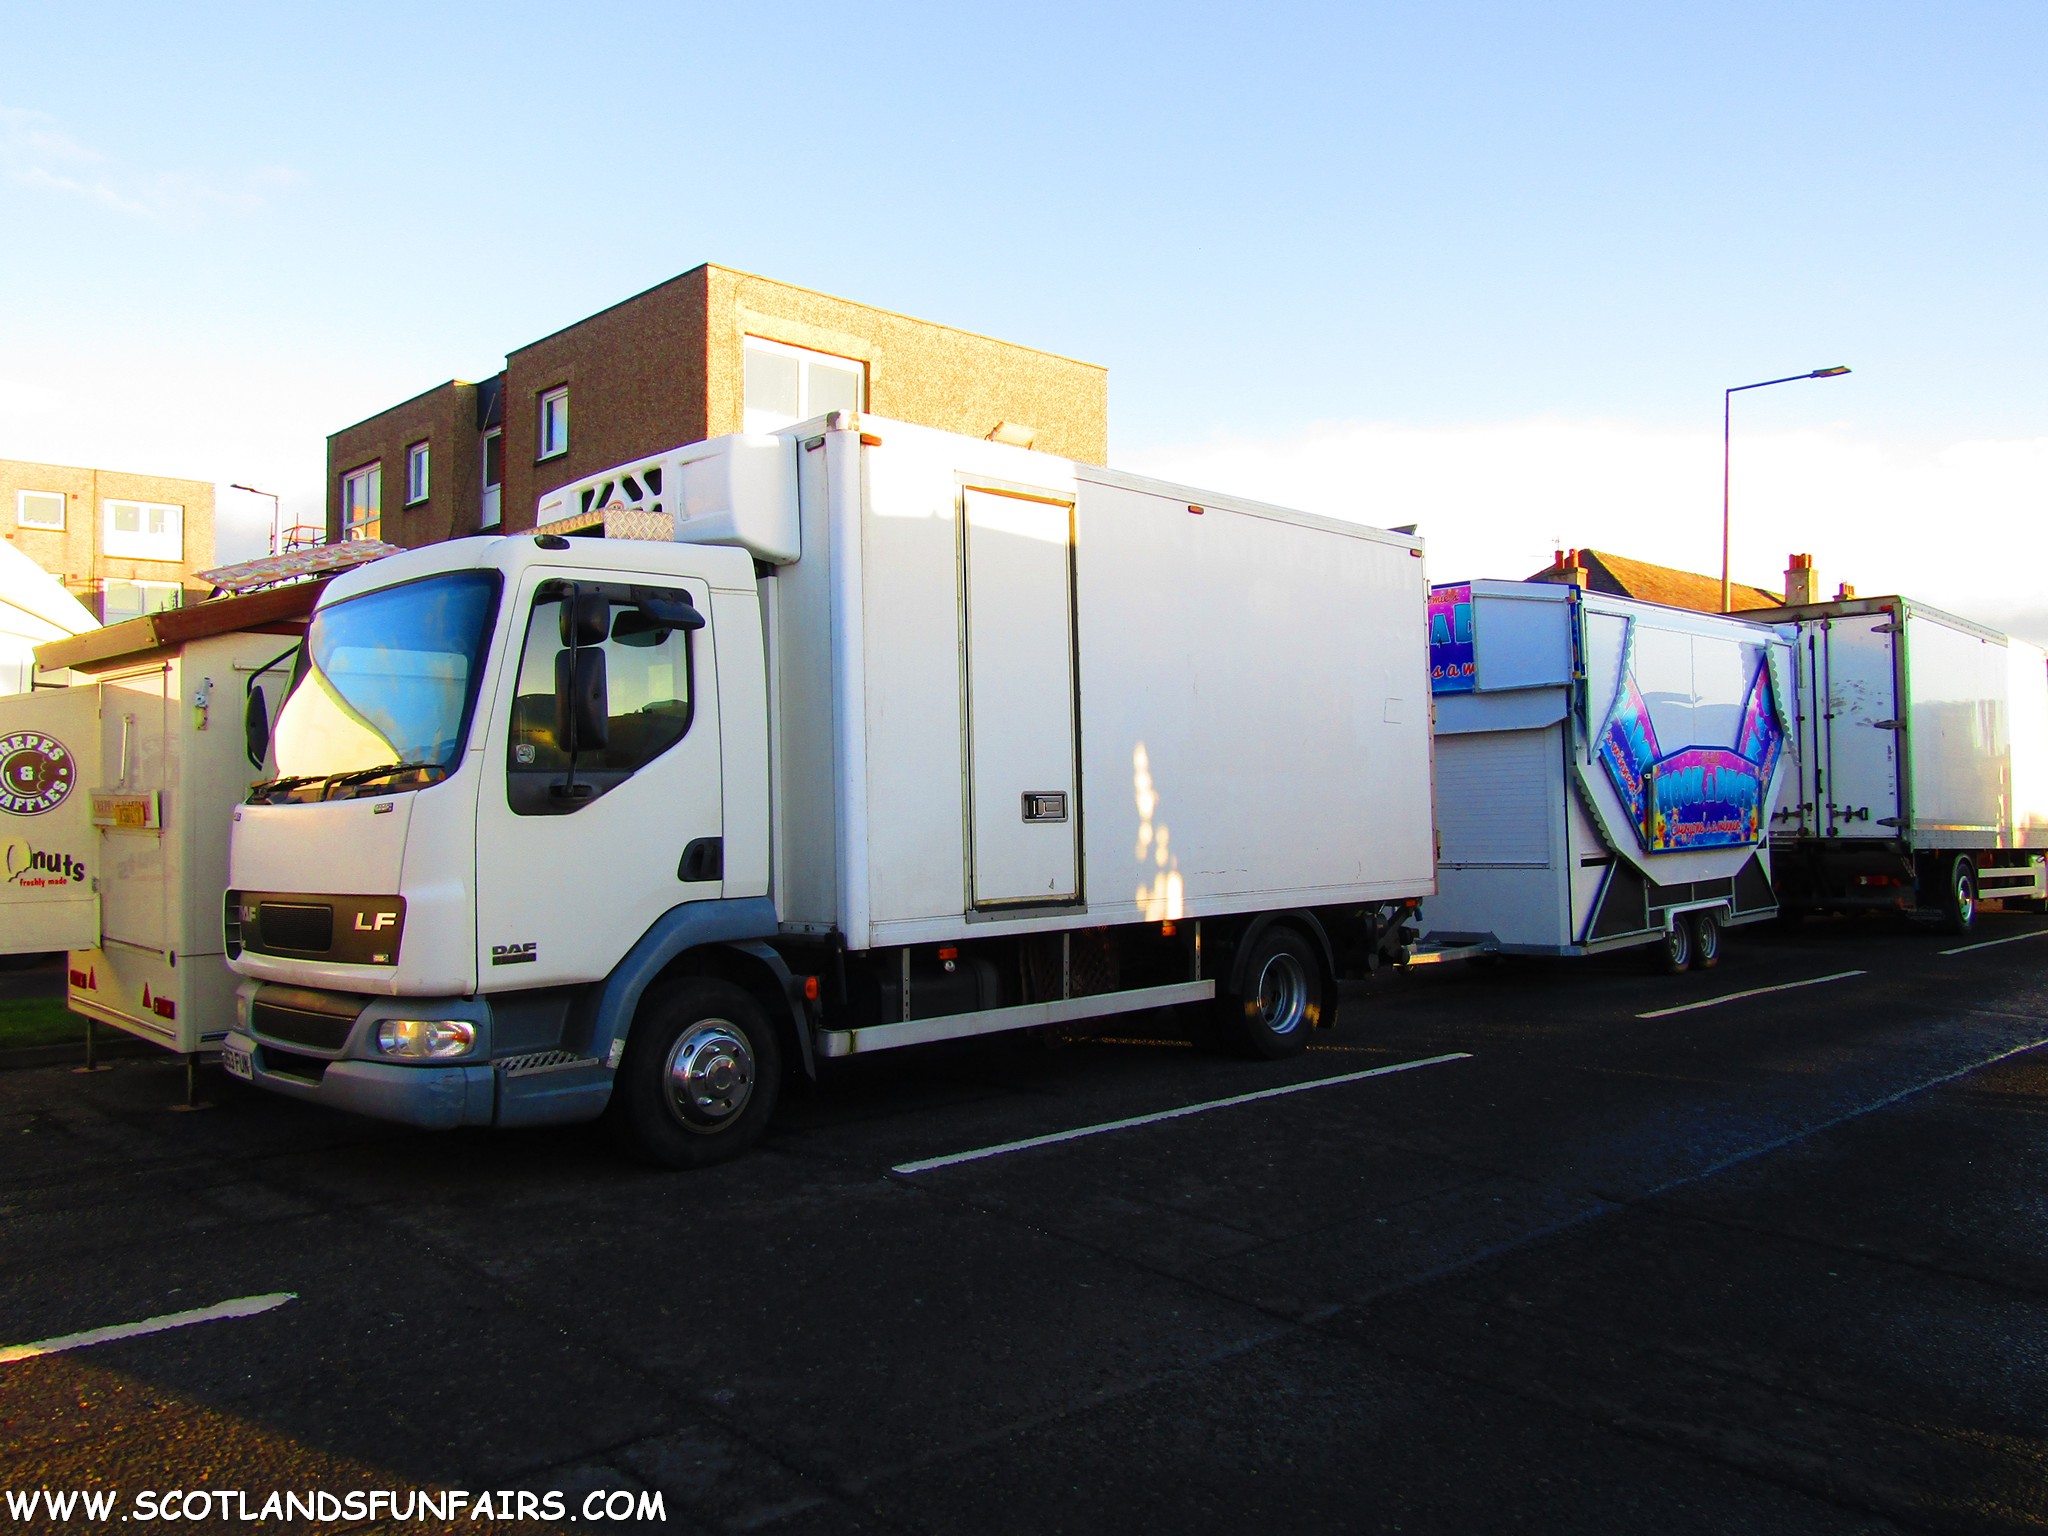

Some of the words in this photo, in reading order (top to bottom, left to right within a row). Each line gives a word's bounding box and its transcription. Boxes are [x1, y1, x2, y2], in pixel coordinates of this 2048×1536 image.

[0, 735, 64, 761] REPES
[0, 780, 67, 811] AFFLES
[1655, 765, 1705, 815] HOOK
[1705, 773, 1716, 803] A
[1715, 765, 1758, 812] DUCK
[20, 877, 46, 888] freshly
[48, 876, 67, 885] made
[354, 912, 398, 931] LF
[492, 942, 537, 956] DAF
